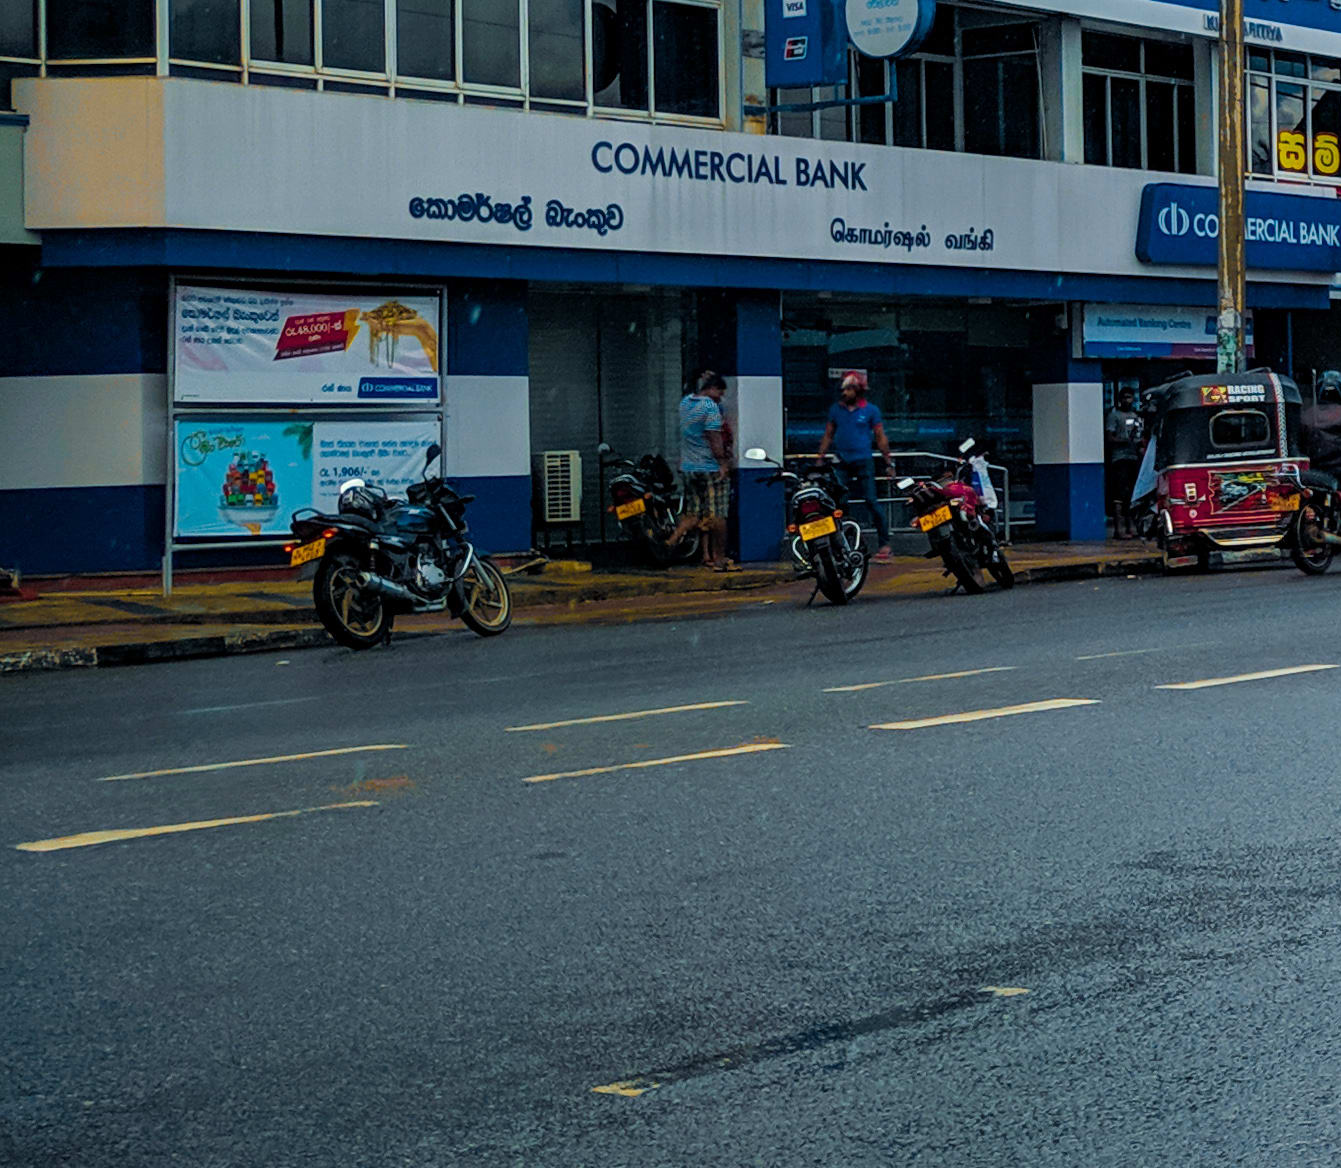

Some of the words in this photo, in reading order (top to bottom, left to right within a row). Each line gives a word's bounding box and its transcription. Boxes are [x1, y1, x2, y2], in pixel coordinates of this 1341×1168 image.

[786, 2, 804, 12] VISA
[591, 141, 787, 185] COMMERCIAL
[795, 158, 868, 191] BANK
[409, 192, 532, 231] කොමර්ෂල්
[545, 199, 624, 237] බැංකුව
[831, 217, 931, 251] கொமர்ஷல்
[945, 228, 994, 252] வங்கி
[1193, 213, 1297, 244] COERCIAL
[1300, 222, 1341, 246] BANK
[1097, 316, 1137, 328] Automated
[1139, 317, 1167, 330] Banking
[1169, 319, 1191, 329] Centre
[1227, 385, 1265, 394] RACING
[1228, 395, 1265, 403] SPORT
